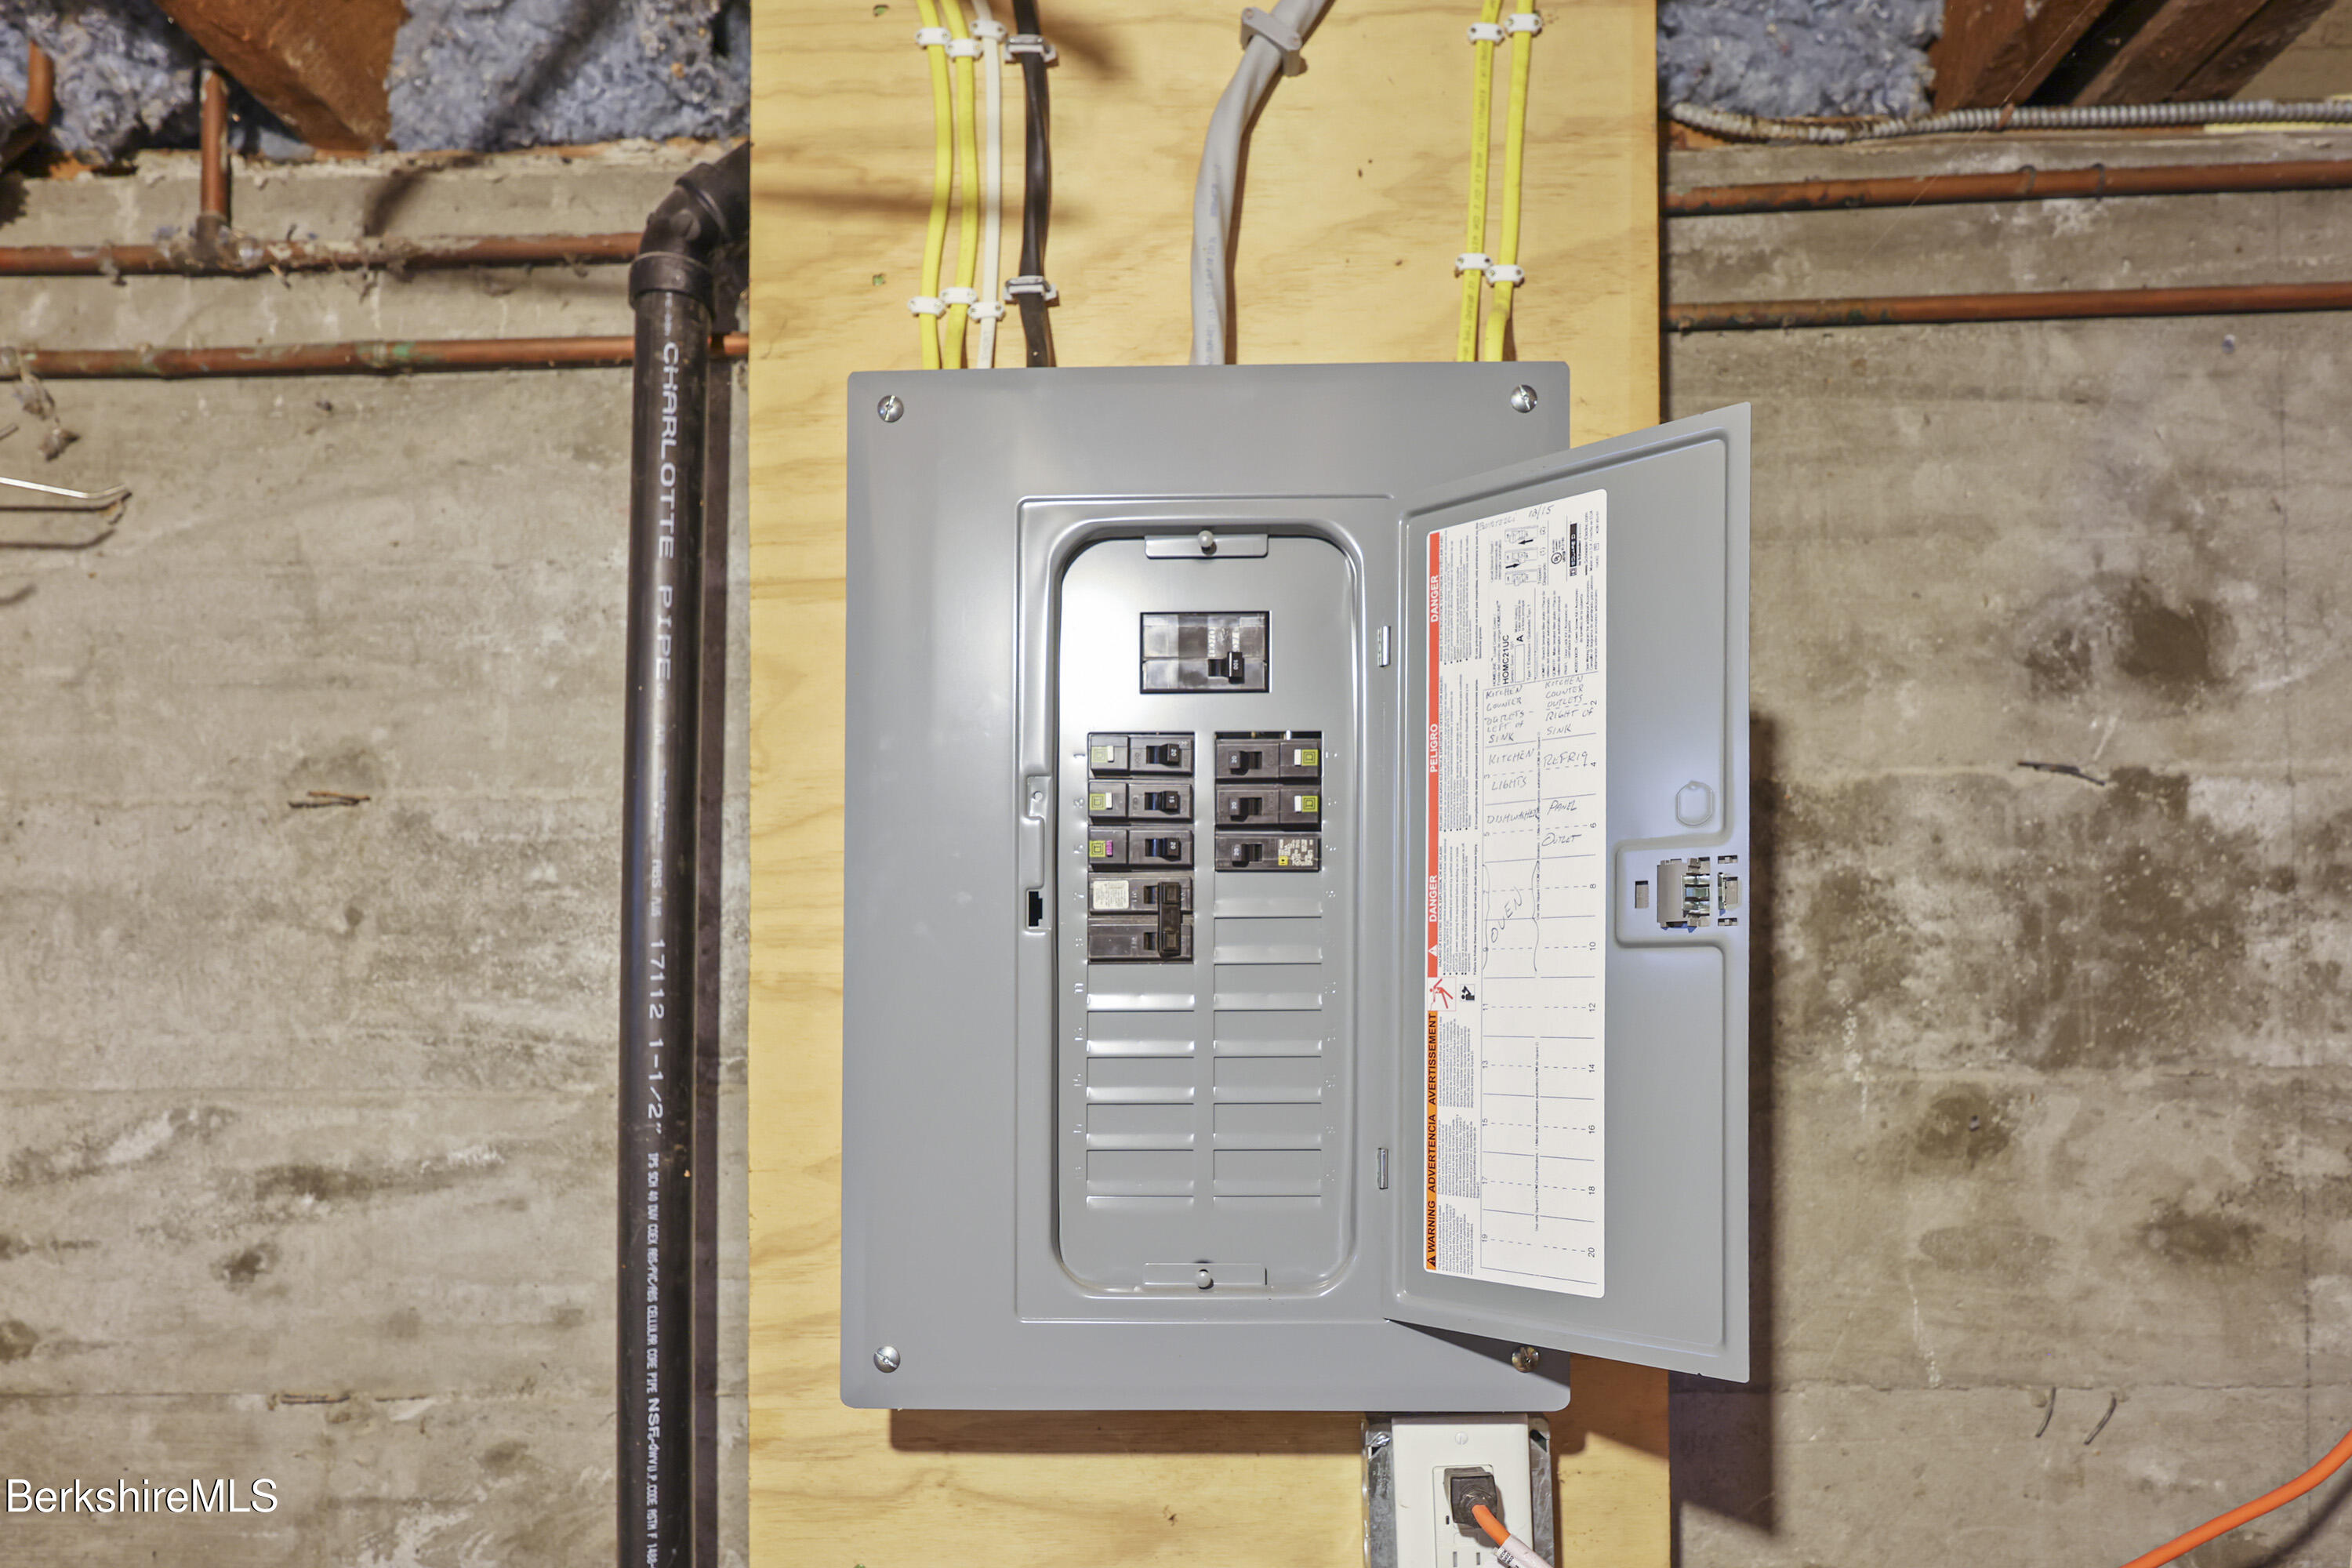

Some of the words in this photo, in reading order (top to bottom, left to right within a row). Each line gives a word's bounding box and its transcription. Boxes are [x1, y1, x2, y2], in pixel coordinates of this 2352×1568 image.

[659, 342, 678, 559] CHARLOTTE
[655, 585, 673, 681] PIPE
[1544, 675, 1583, 688] KITCHEN
[1486, 684, 1523, 699] KITCHEN
[1545, 684, 1584, 699] COUNTER
[1486, 696, 1523, 711] COUNTER
[1547, 695, 1583, 709] OUTLETS
[1545, 709, 1579, 721] RIGHT
[1486, 722, 1510, 733] LEFT
[1547, 724, 1571, 735] SINK
[1488, 732, 1514, 744] SINK
[1171, 748, 1177, 757] 20
[1489, 748, 1535, 766] KITCHEN
[1491, 775, 1527, 791] LIGHTS
[1169, 795, 1175, 804] 15
[1547, 800, 1577, 815] PANEL
[1171, 841, 1177, 850] 20
[1541, 832, 1583, 847] OUTLET
[1490, 885, 1523, 943] OVEN
[1589, 942, 1596, 950] 10
[649, 938, 665, 1019] 17112
[1588, 1003, 1596, 1011] 12
[1482, 1060, 1488, 1069] 13
[1589, 1064, 1595, 1073] 14
[1482, 1118, 1487, 1127] 15
[1589, 1124, 1595, 1134] 16
[647, 1190, 659, 1201] 40
[1589, 1186, 1595, 1195] 18
[1588, 1247, 1595, 1258] 20
[646, 1305, 659, 1346] CELLULAR
[646, 1348, 658, 1370] CORE
[646, 1373, 658, 1394] PIPE
